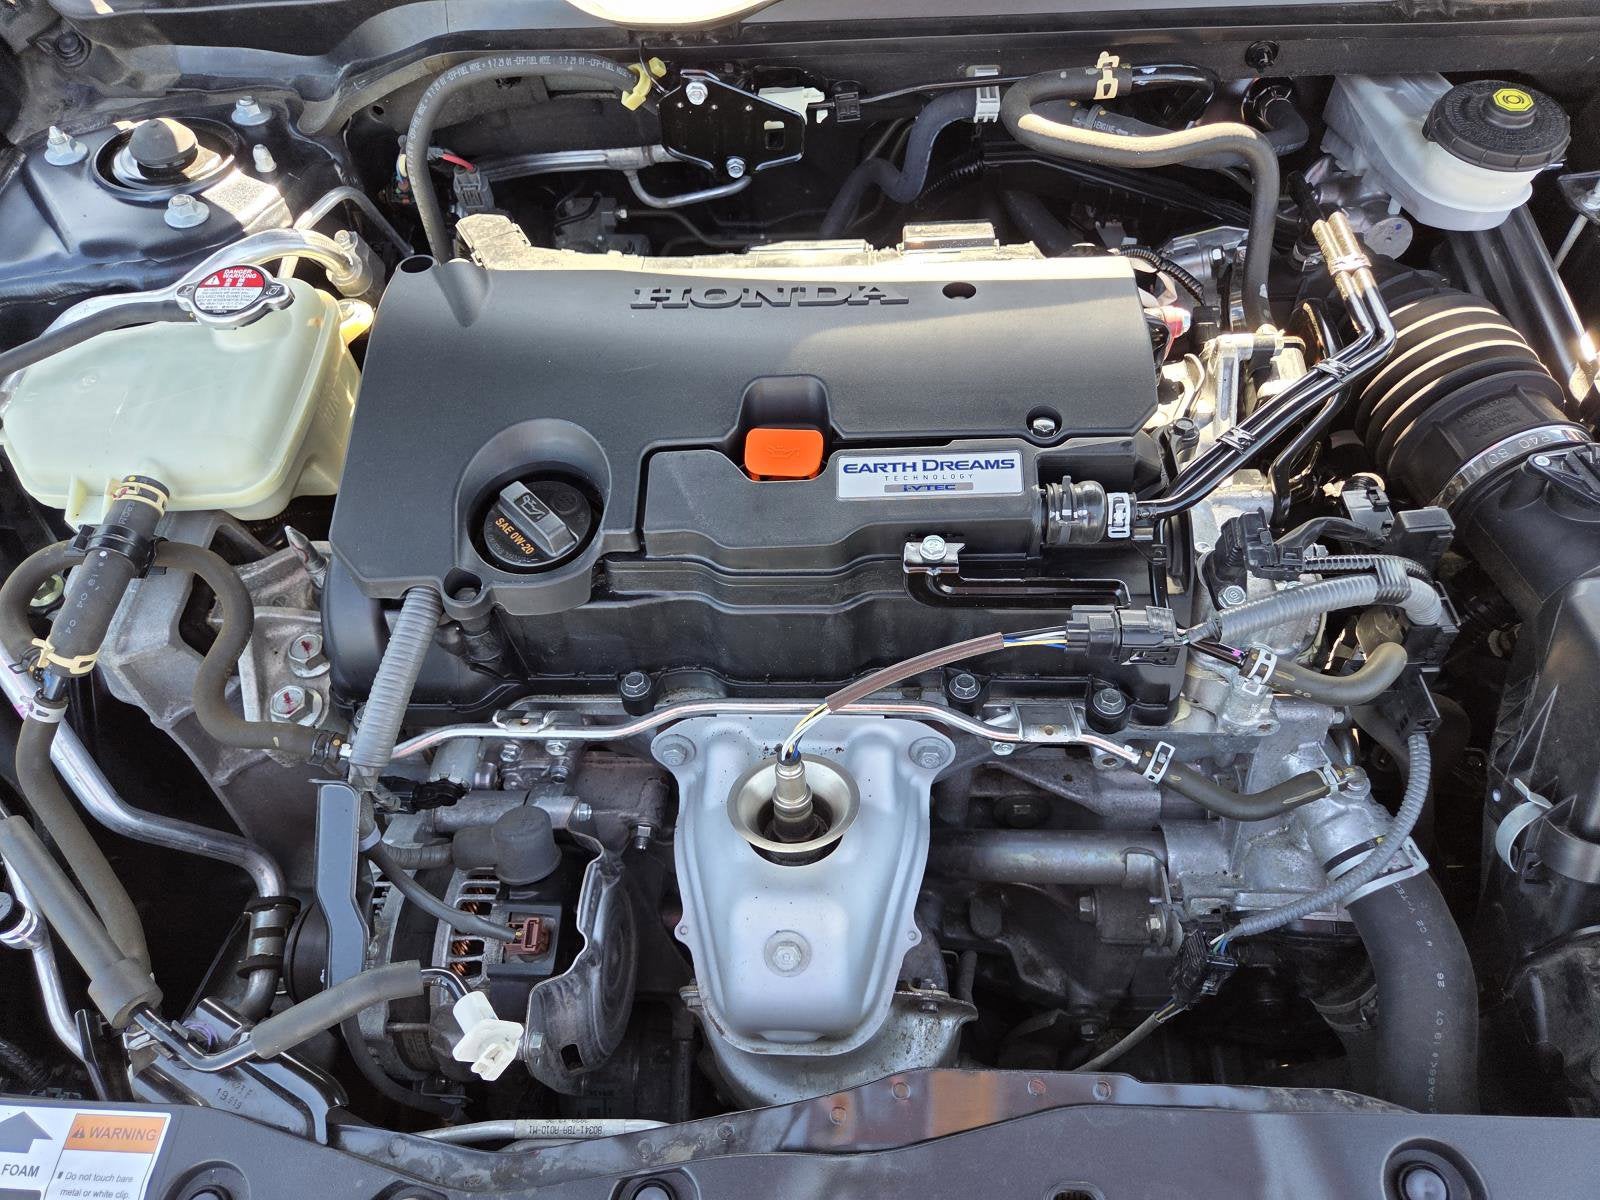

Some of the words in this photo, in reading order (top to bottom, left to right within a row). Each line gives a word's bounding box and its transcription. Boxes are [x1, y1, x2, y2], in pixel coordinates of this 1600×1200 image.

[630, 286, 909, 310] HONDA
[843, 459, 917, 475] EARTH
[922, 458, 1016, 473] DREAMS
[884, 473, 974, 482] TECHNOLOGY
[495, 517, 515, 535] SAE
[510, 532, 535, 555] 0W-20
[89, 1126, 157, 1142] WARNING
[1, 1163, 41, 1178] FOAM
[64, 1171, 77, 1181] Do
[79, 1172, 92, 1182] not
[93, 1173, 115, 1183] touch
[116, 1173, 134, 1184] bare
[60, 1188, 82, 1198] metal
[83, 1190, 92, 1198] or
[93, 1189, 114, 1199] white
